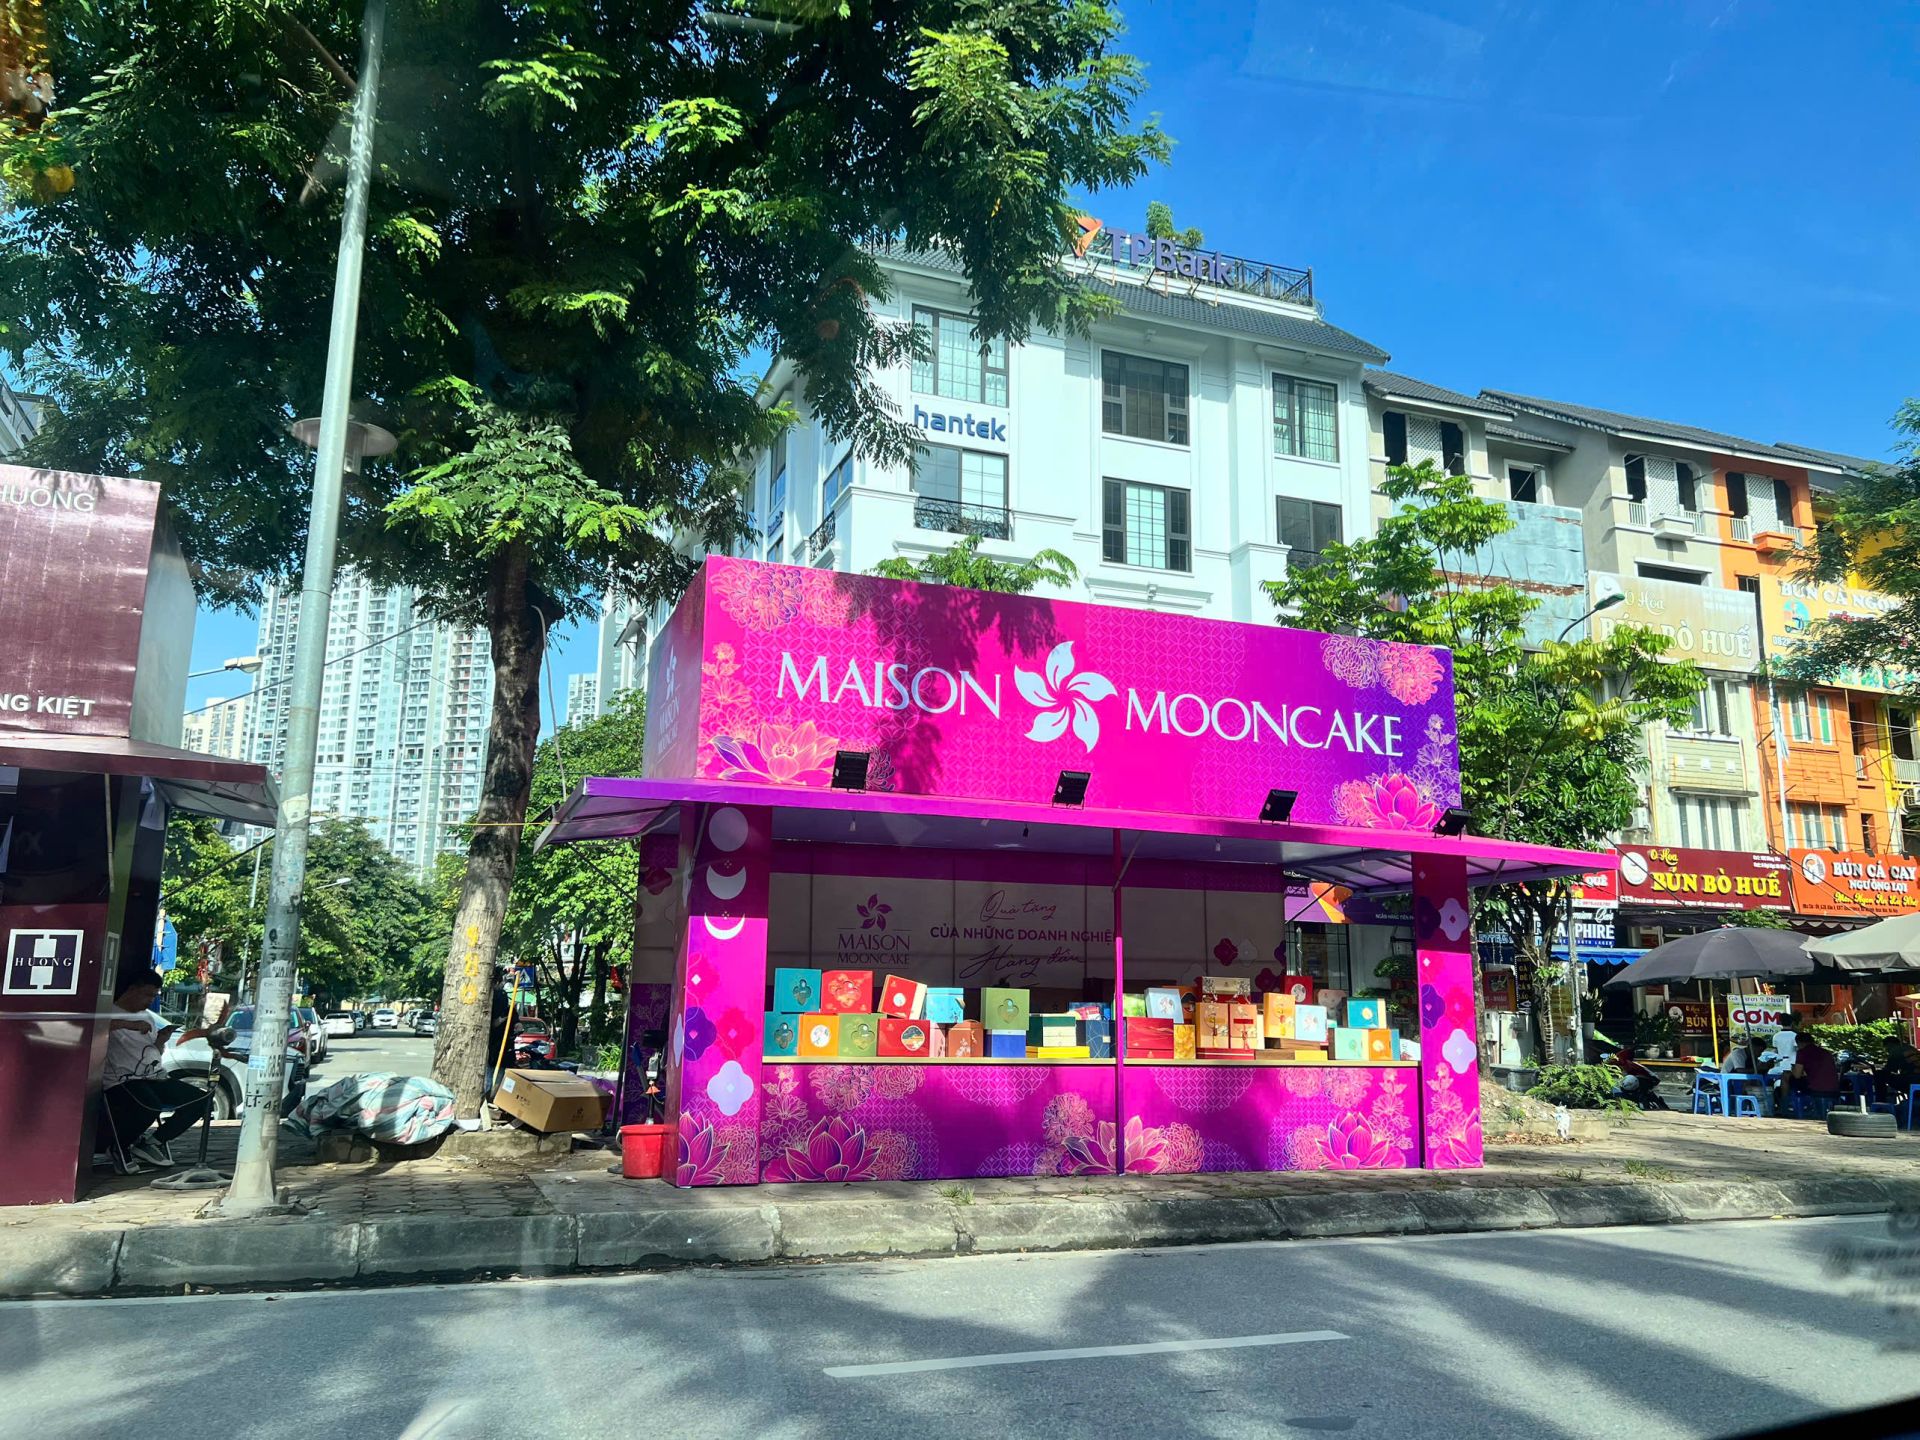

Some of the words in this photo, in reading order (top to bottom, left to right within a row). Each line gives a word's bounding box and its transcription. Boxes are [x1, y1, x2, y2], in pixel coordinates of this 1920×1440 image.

[1104, 227, 1235, 287] TPBank
[914, 404, 1006, 442] hantek
[1701, 623, 1752, 659] HUẾ
[37, 695, 96, 719] KIỆT
[776, 651, 1001, 720] MAISON
[1125, 687, 1403, 757] MOONCAKE
[1832, 858, 1862, 877] BÚN
[1866, 859, 1887, 879] CÁ
[1890, 865, 1917, 880] CAY
[1650, 866, 1698, 893] BÚN
[1702, 868, 1732, 895] BÒ
[1735, 870, 1782, 897] HUẾ
[838, 933, 910, 951] MAISON
[930, 923, 960, 939] CỦA
[963, 925, 1015, 940] NHỮNG
[1018, 929, 1067, 942] DOANH
[1071, 928, 1113, 946] NGHIỆ
[1548, 922, 1616, 940] APHIRE
[15, 957, 72, 967] HUONG
[837, 952, 910, 965] MOONCAKE
[1685, 1014, 1709, 1028] BÚN
[1732, 1009, 1782, 1026] CƠM
